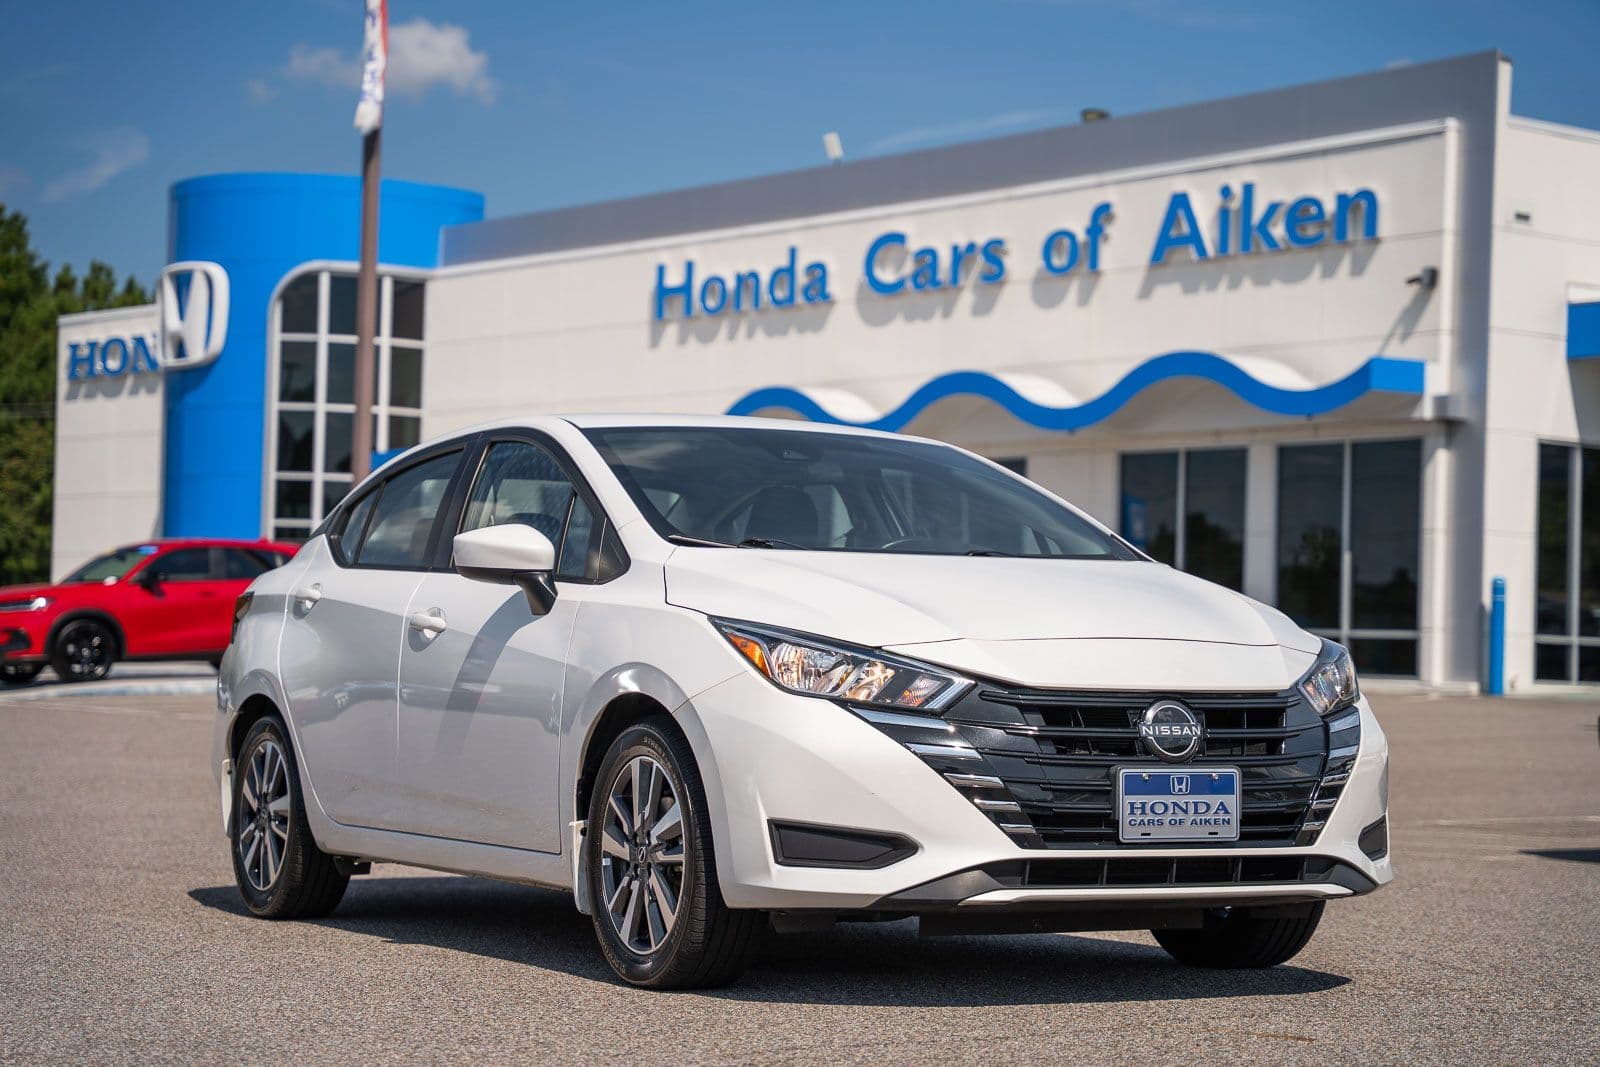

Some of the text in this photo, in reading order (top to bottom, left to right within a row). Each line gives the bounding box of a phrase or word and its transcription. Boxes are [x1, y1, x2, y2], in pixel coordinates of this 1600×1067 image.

[655, 183, 1379, 320] Honda Cars of Aiken
[1142, 725, 1201, 736] NISSAN
[1127, 800, 1232, 816] HONDA
[1128, 817, 1231, 827] CARS OF AIKEN
